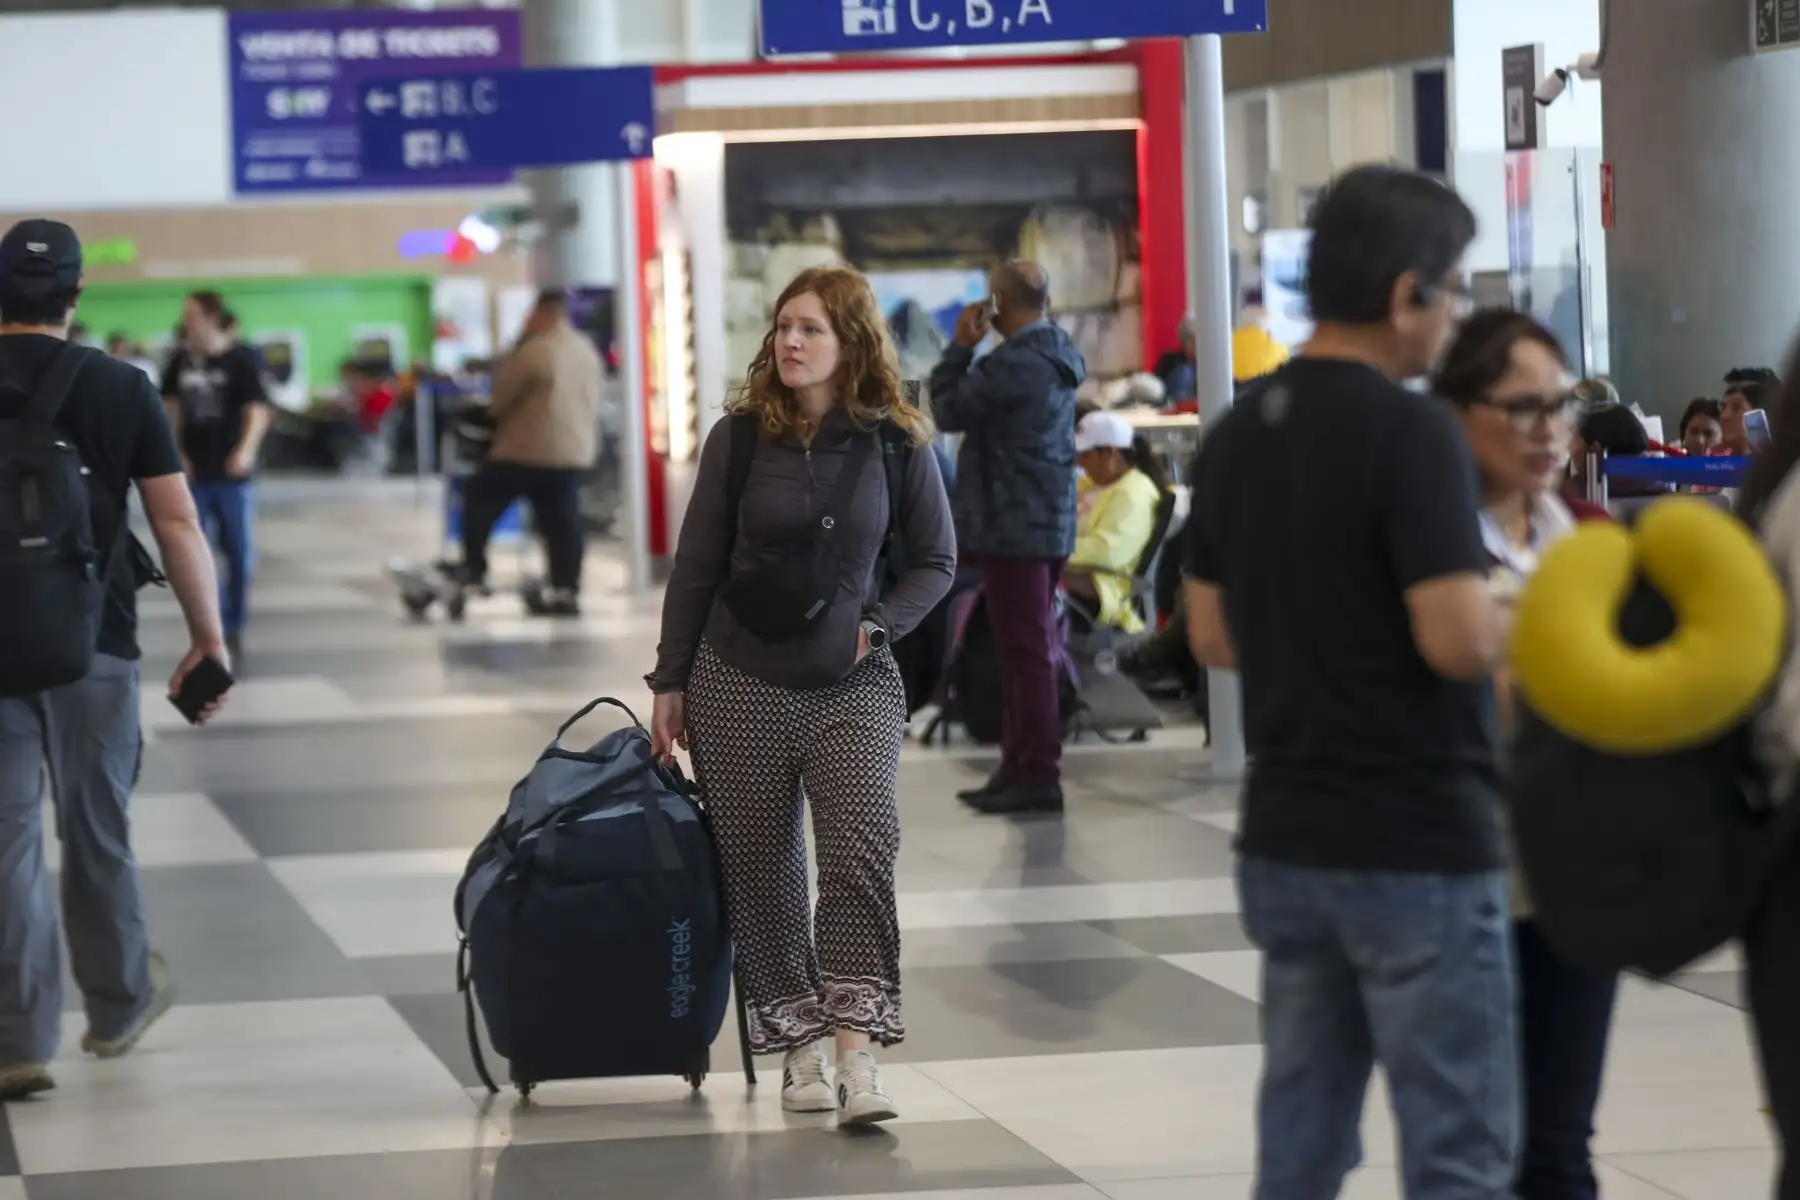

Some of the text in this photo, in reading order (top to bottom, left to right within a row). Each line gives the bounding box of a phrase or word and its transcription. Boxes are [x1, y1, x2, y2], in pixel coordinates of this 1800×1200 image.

[239, 27, 499, 59] VENTA DE TICKETS
[446, 131, 470, 161] A
